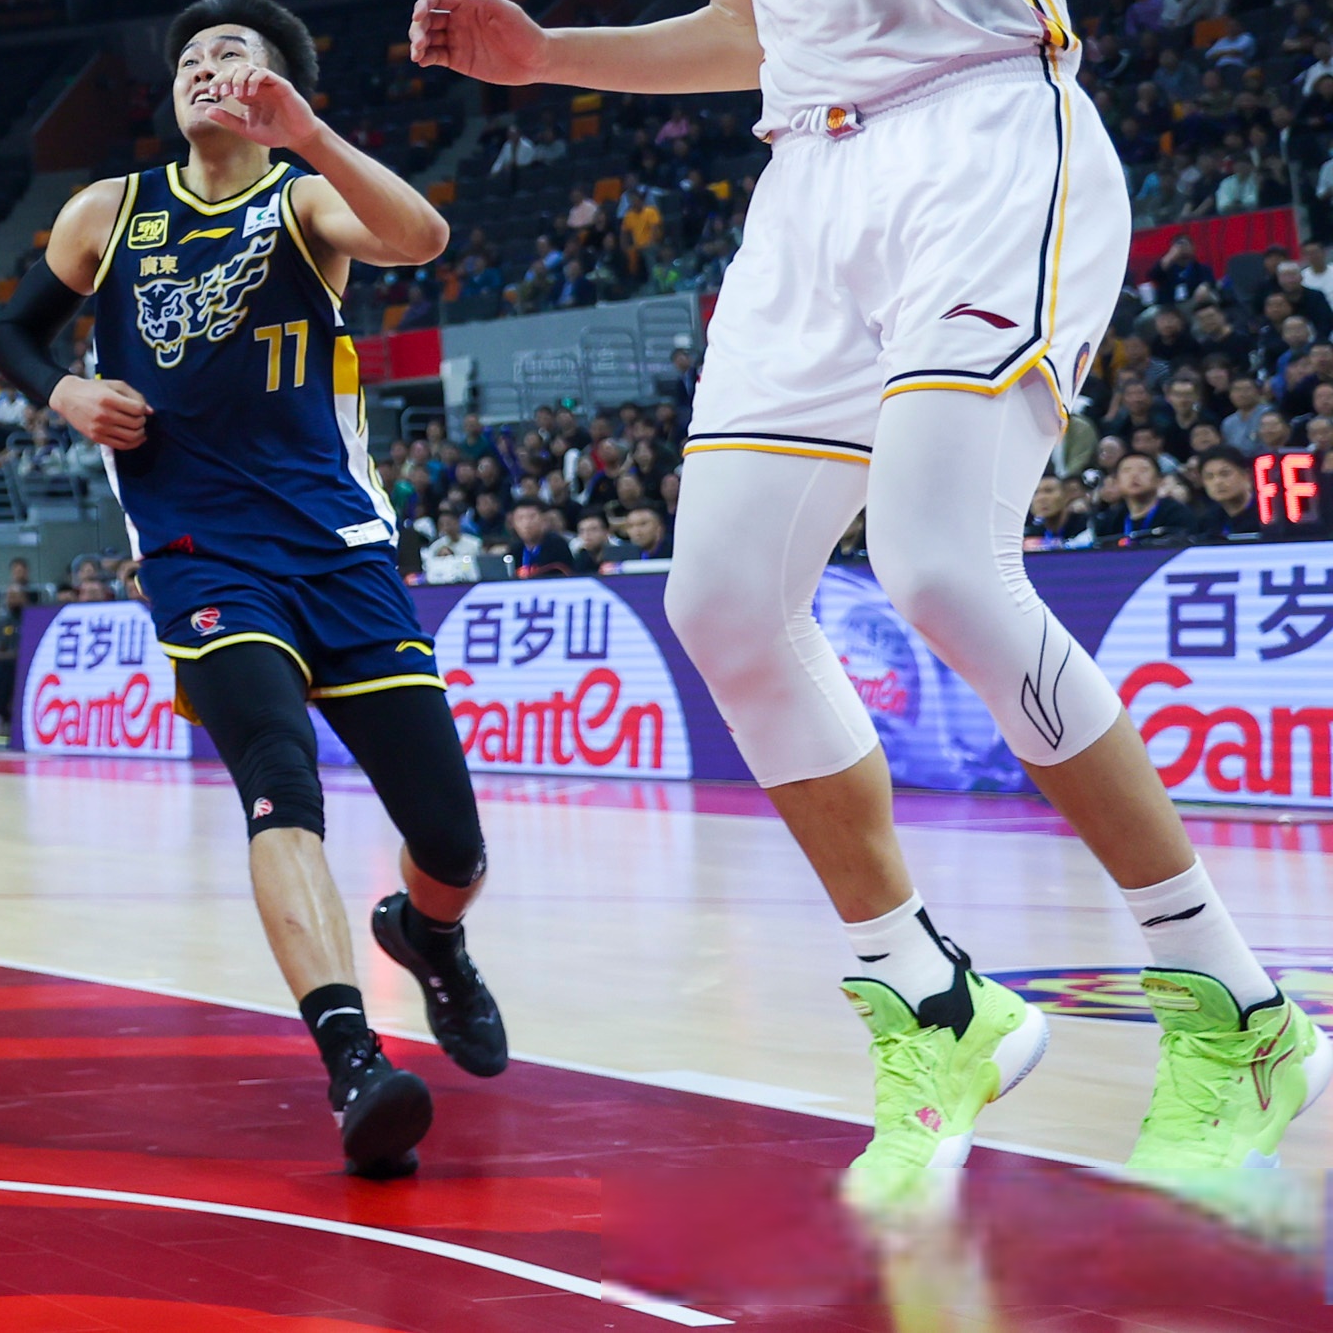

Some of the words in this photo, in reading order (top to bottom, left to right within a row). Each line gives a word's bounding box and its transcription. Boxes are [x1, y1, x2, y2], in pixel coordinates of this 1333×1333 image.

[139, 254, 179, 278] 廣東
[254, 319, 308, 392] 77
[56, 615, 147, 671] 百岁山
[464, 597, 611, 667] 百岁山
